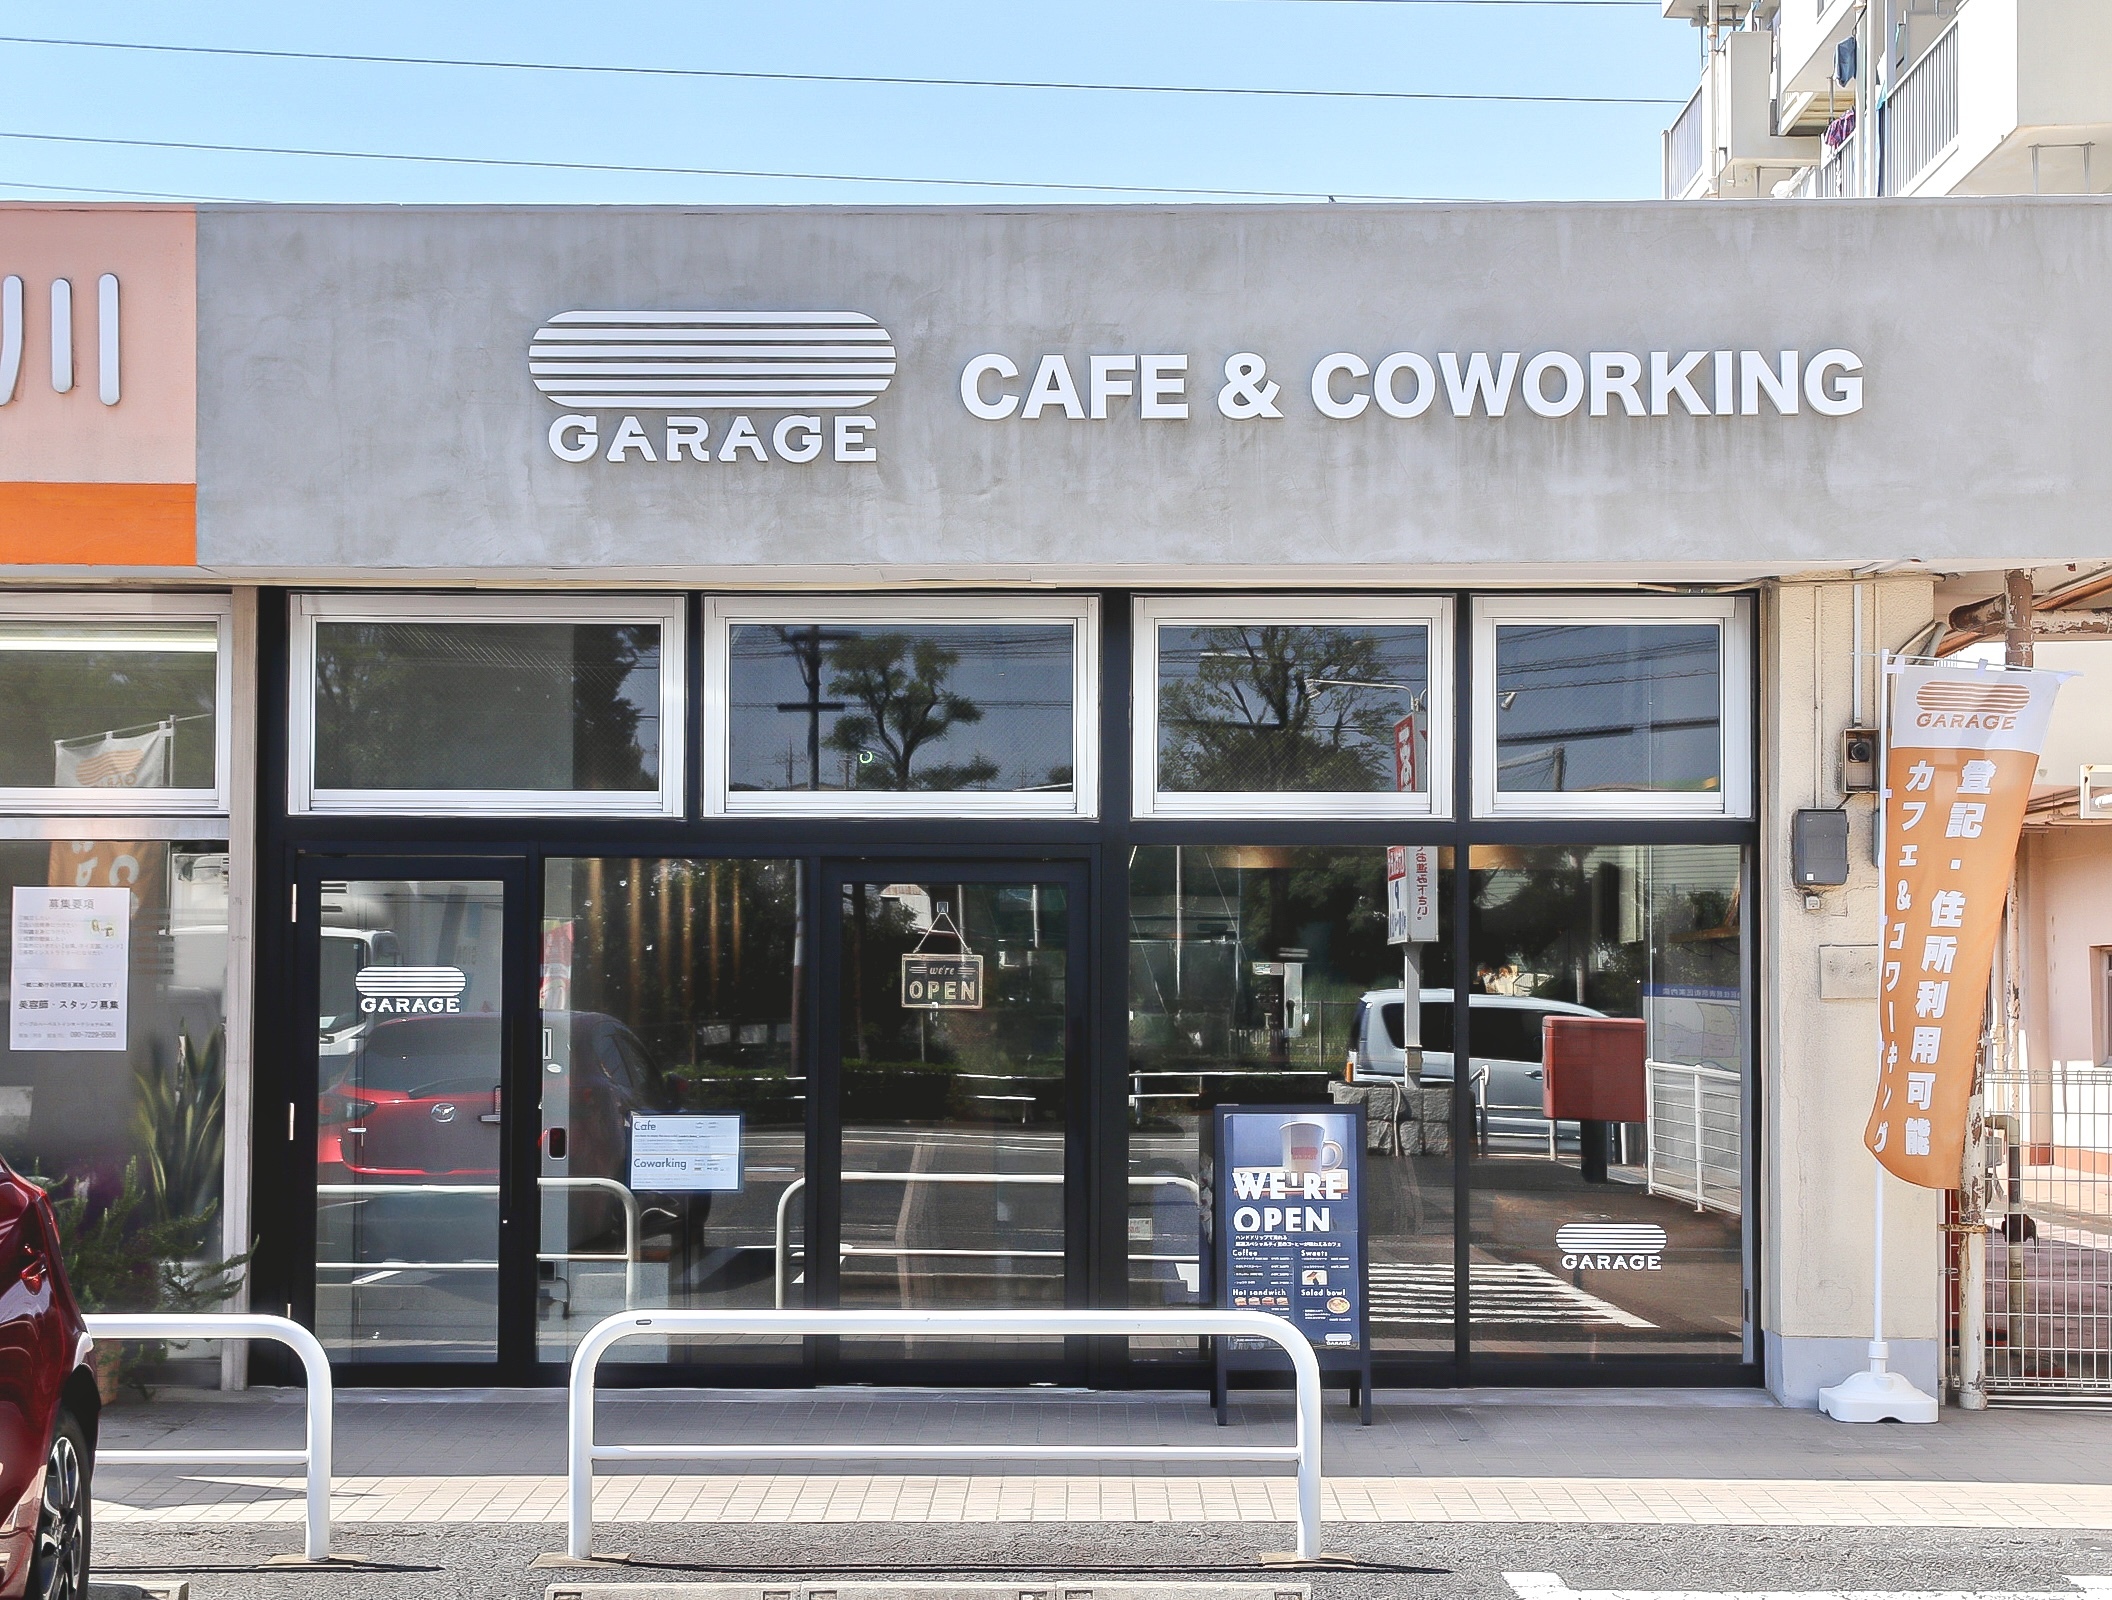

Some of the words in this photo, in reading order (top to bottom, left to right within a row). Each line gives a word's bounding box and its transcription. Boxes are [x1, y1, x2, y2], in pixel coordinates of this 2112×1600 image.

[960, 353, 1190, 421] CAFE
[1217, 351, 1286, 420] &
[1310, 348, 1865, 420] COWORKING
[547, 414, 878, 464] GARAGE
[1915, 711, 2018, 732] GARAGE
[1903, 758, 1999, 1158] 登記・住所利用可能
[908, 980, 976, 1001] OPEN
[18, 999, 120, 1010] 美容師・スタッフ募集
[360, 997, 461, 1013] GARAGE
[633, 1119, 657, 1131] Cafe
[633, 1158, 687, 1171] Coworking
[1232, 1171, 1343, 1200] WE'RE
[1233, 1206, 1330, 1232] OPEN
[1232, 1249, 1258, 1257] Coffee
[1301, 1249, 1328, 1257] Sweets
[1561, 1254, 1662, 1271] GARAGE
[1232, 1288, 1247, 1296] Hot
[1249, 1288, 1287, 1296] sandwich
[1301, 1289, 1324, 1297] Salad
[1326, 1289, 1346, 1297] bowl
